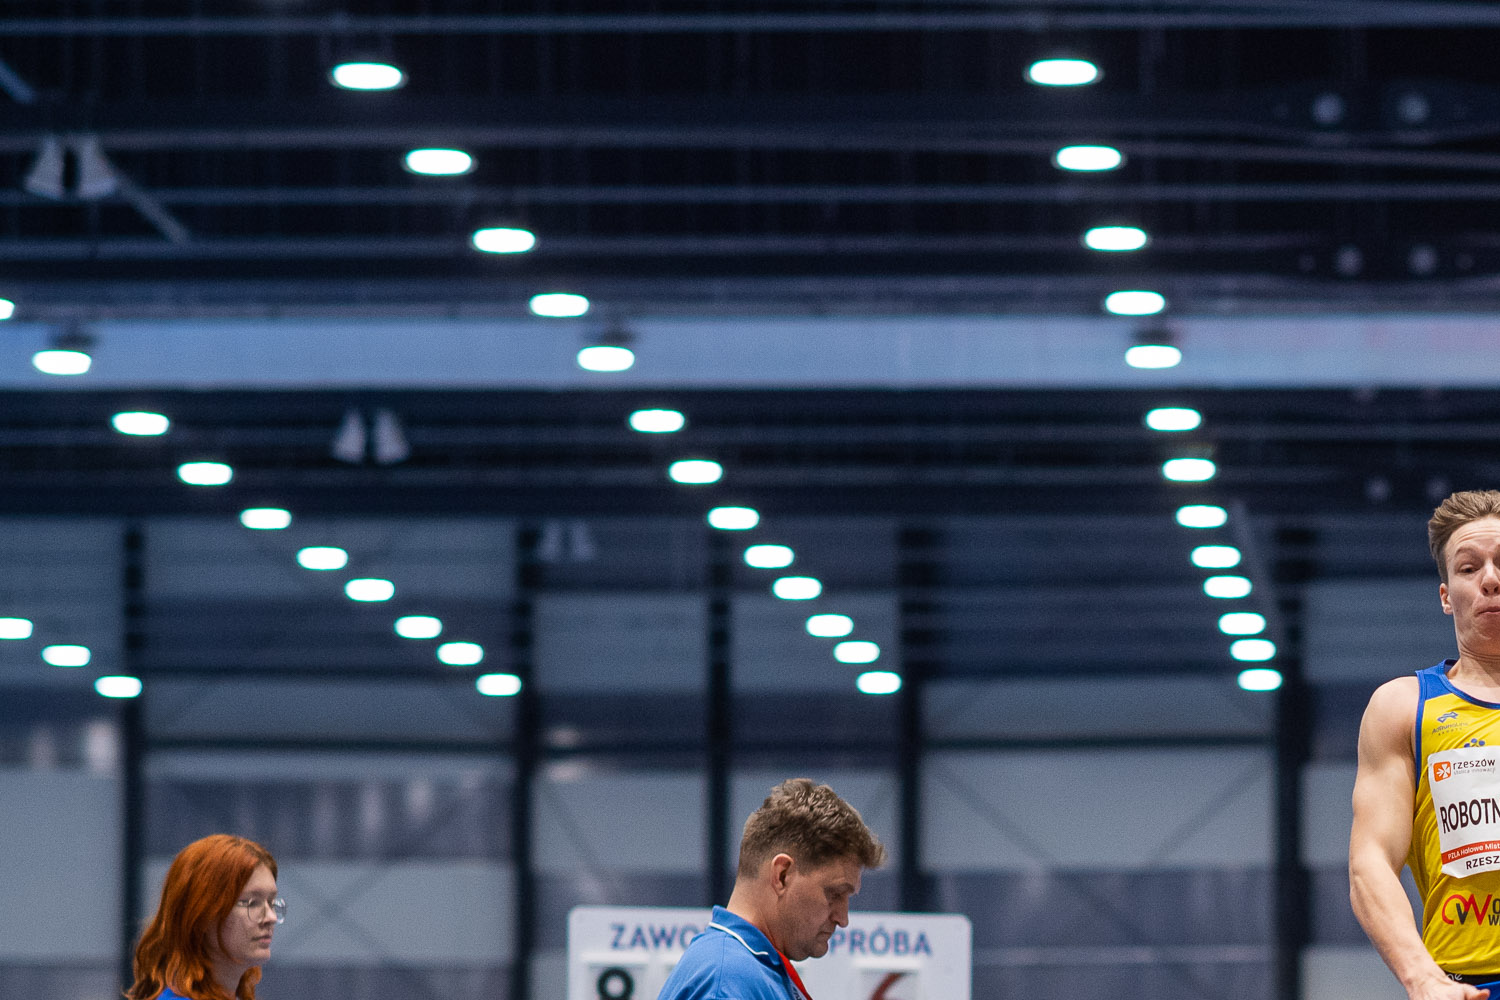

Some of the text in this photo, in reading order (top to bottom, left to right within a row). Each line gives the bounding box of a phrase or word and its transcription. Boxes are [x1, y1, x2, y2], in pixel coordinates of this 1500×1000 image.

[1453, 758, 1496, 770] rzeszów
[1447, 851, 1461, 860] PZLA
[610, 922, 701, 951] ZAWO
[830, 924, 934, 957] PRÓBA
